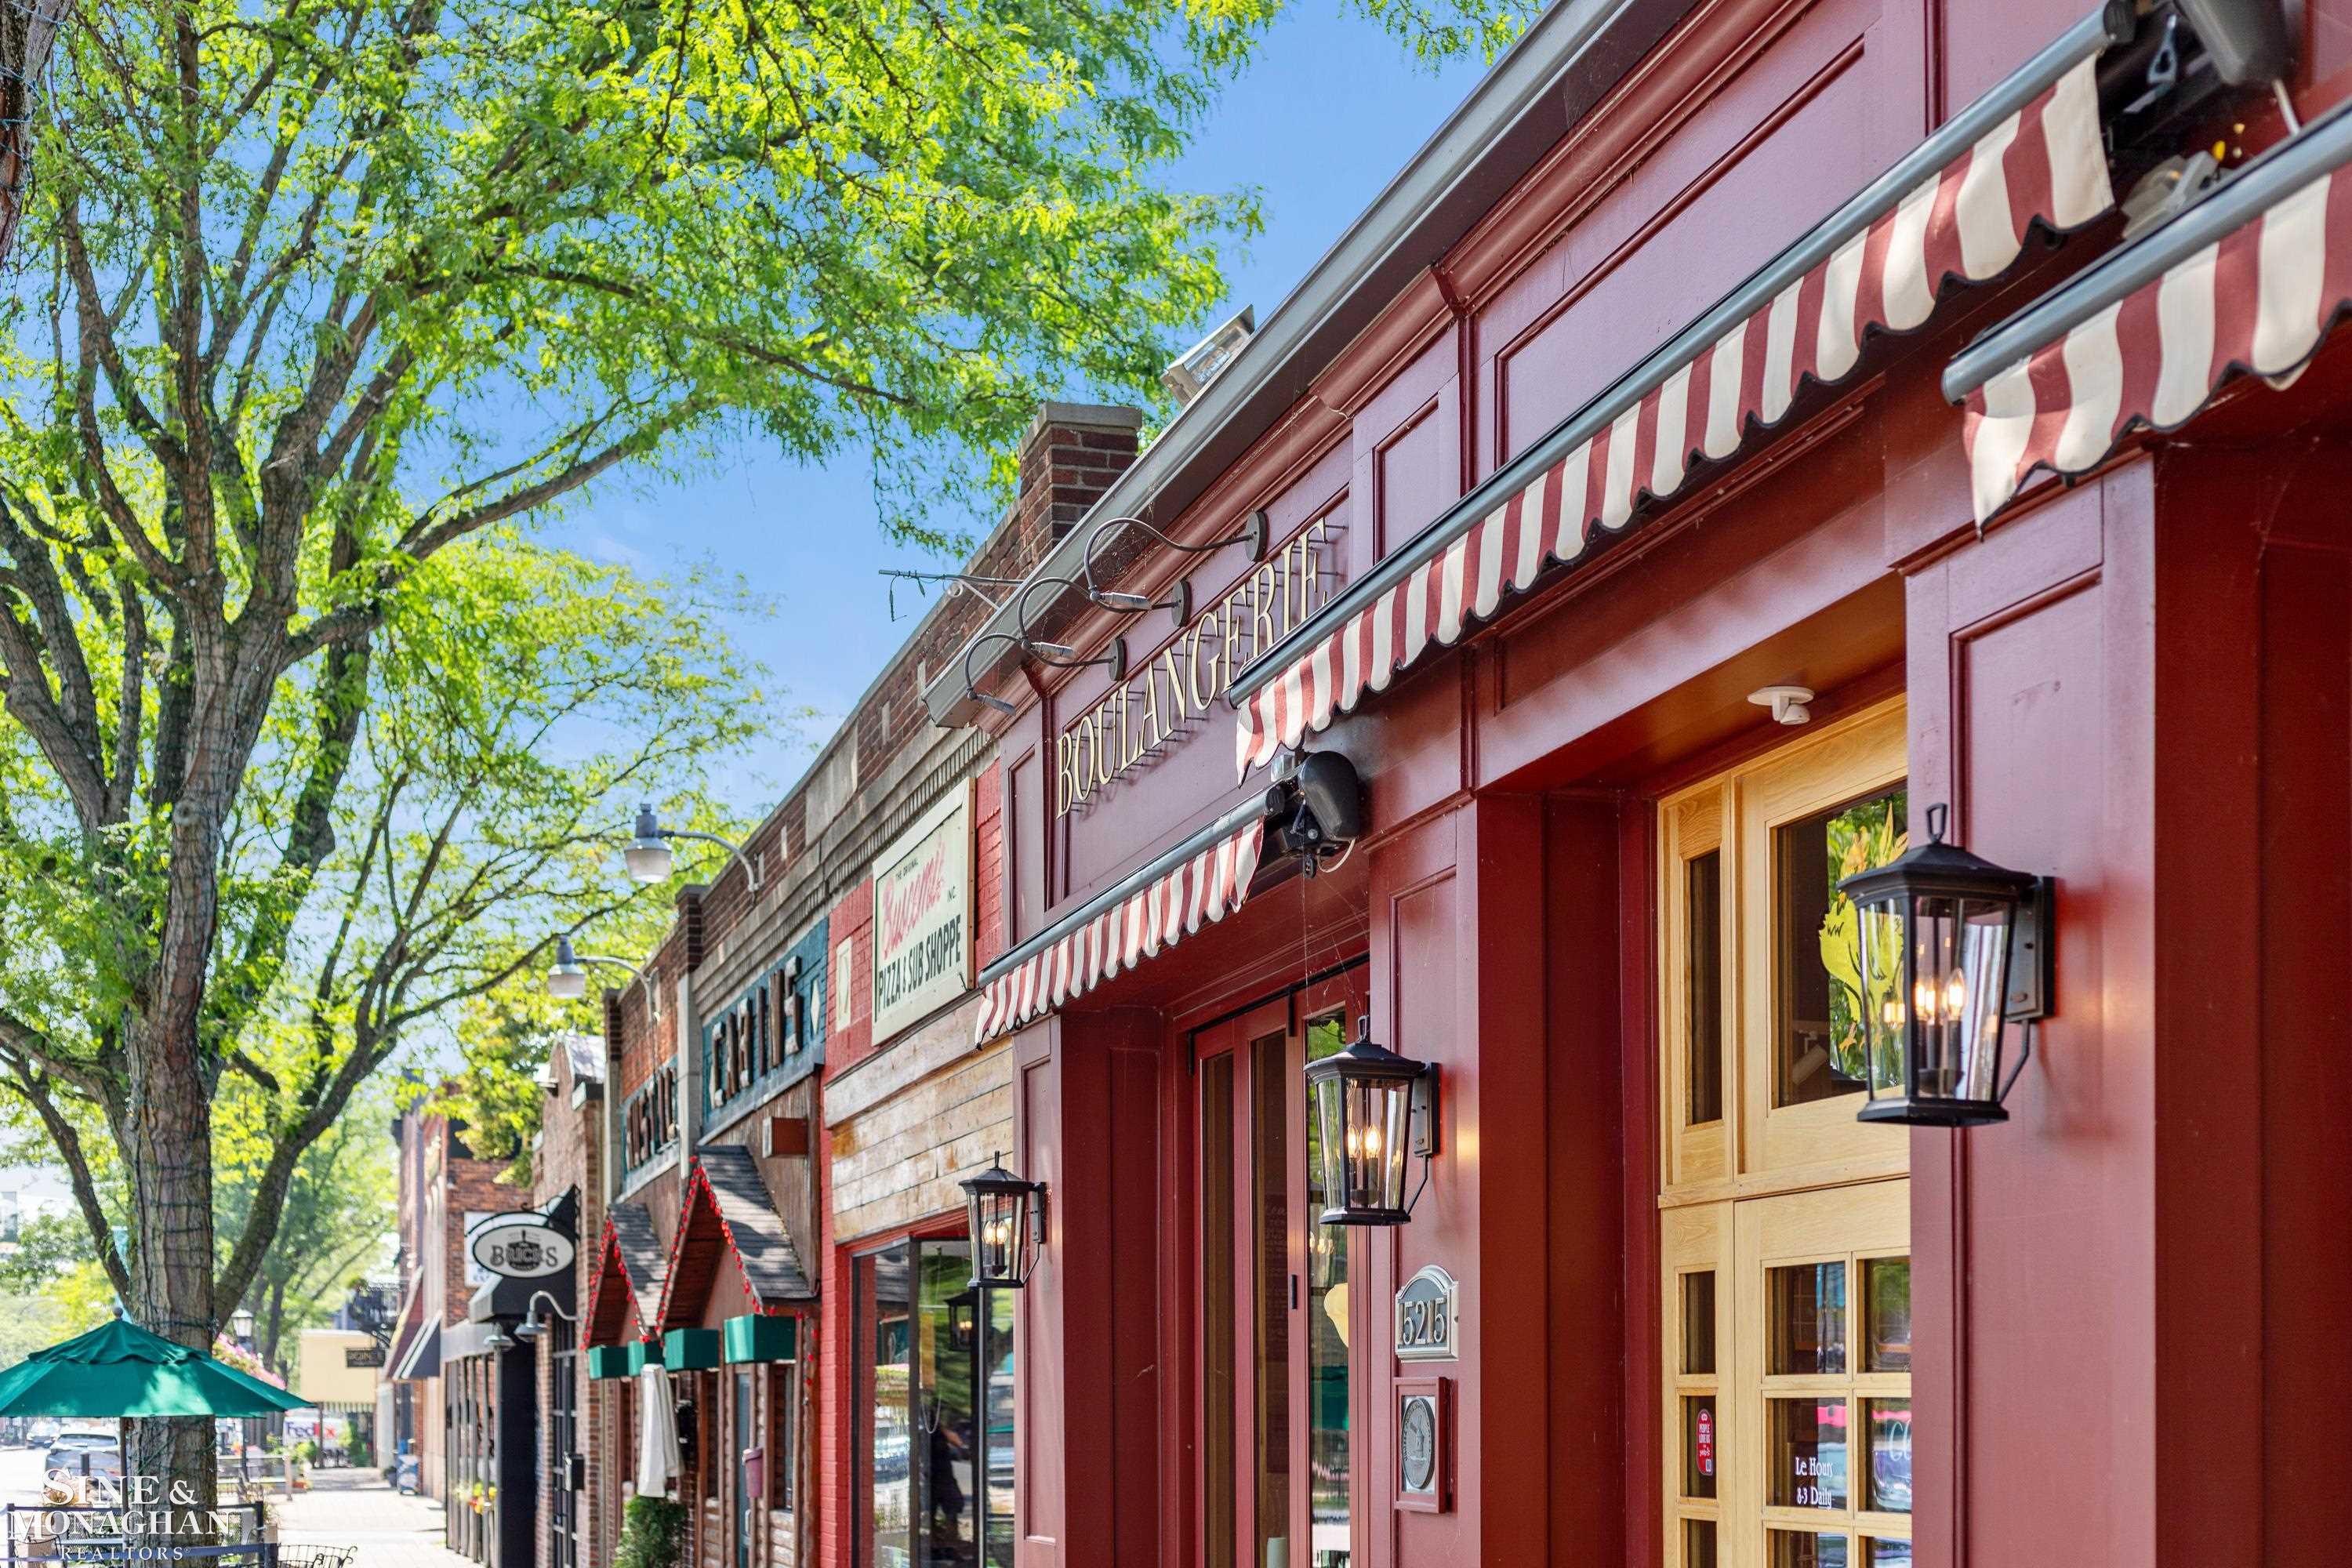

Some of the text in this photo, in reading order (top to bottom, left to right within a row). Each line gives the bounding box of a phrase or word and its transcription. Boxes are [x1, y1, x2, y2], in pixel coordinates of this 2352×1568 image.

[1056, 517, 1327, 819] BOULANGERIE
[878, 957, 901, 1012] PIZZA
[908, 941, 924, 993] SUB
[925, 913, 960, 982] SHOPPE
[1795, 1457, 1833, 1477] Le Hours
[1796, 1487, 1832, 1509] 8-3 Daily
